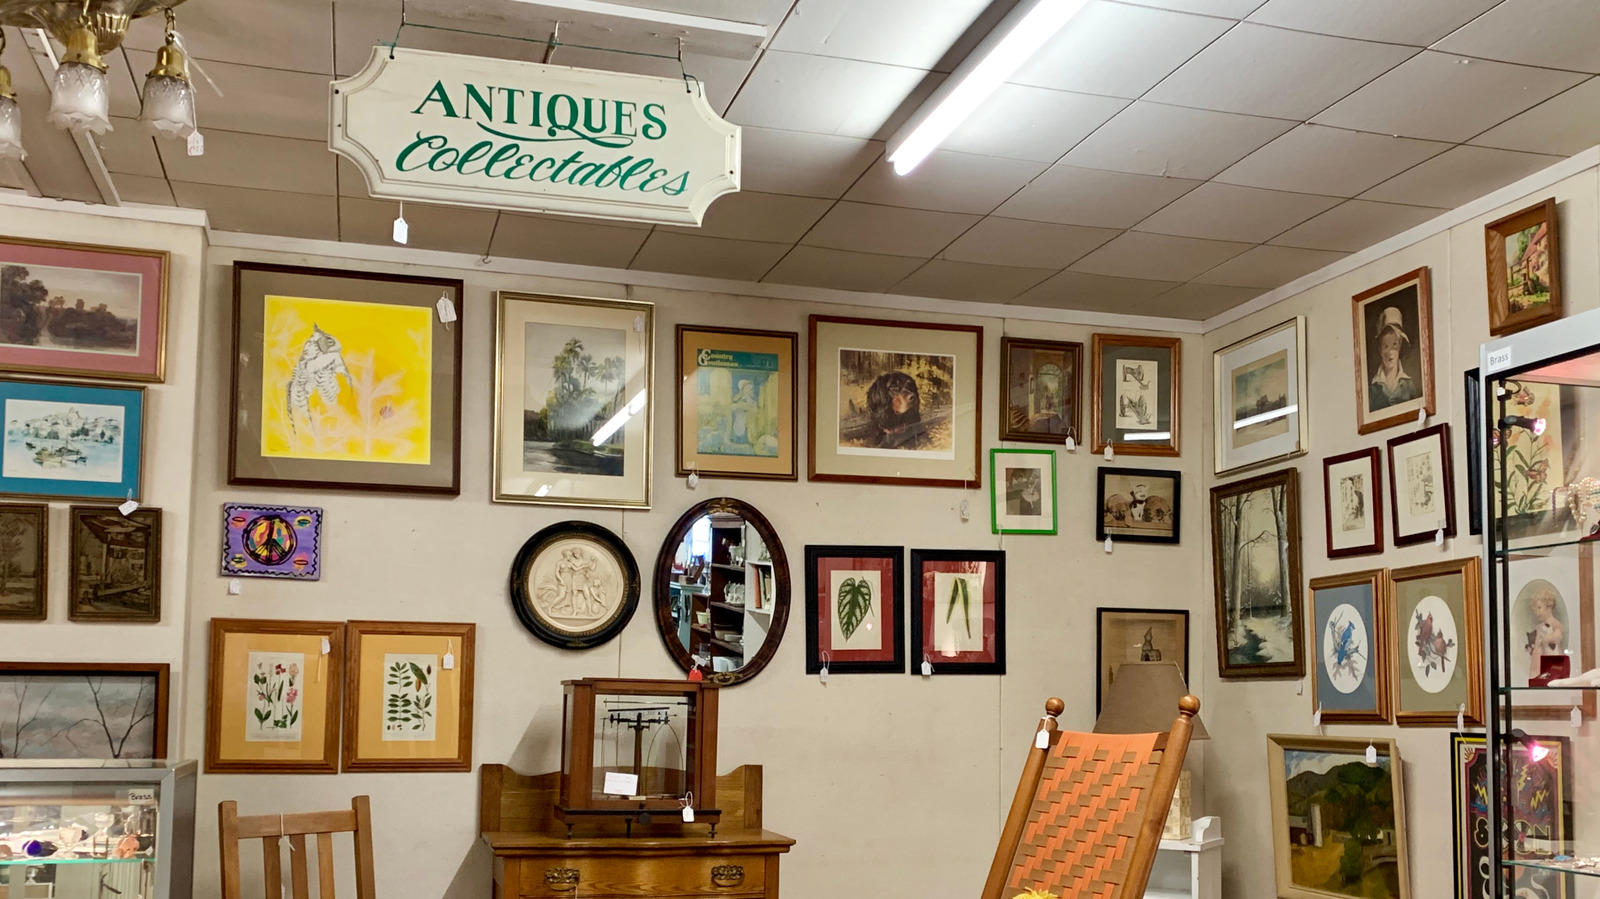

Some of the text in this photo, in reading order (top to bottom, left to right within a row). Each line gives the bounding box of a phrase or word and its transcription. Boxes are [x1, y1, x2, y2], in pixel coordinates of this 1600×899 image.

[411, 79, 668, 146] ANTIQUES
[395, 131, 690, 196] Collectables
[1489, 354, 1509, 366] Brass
